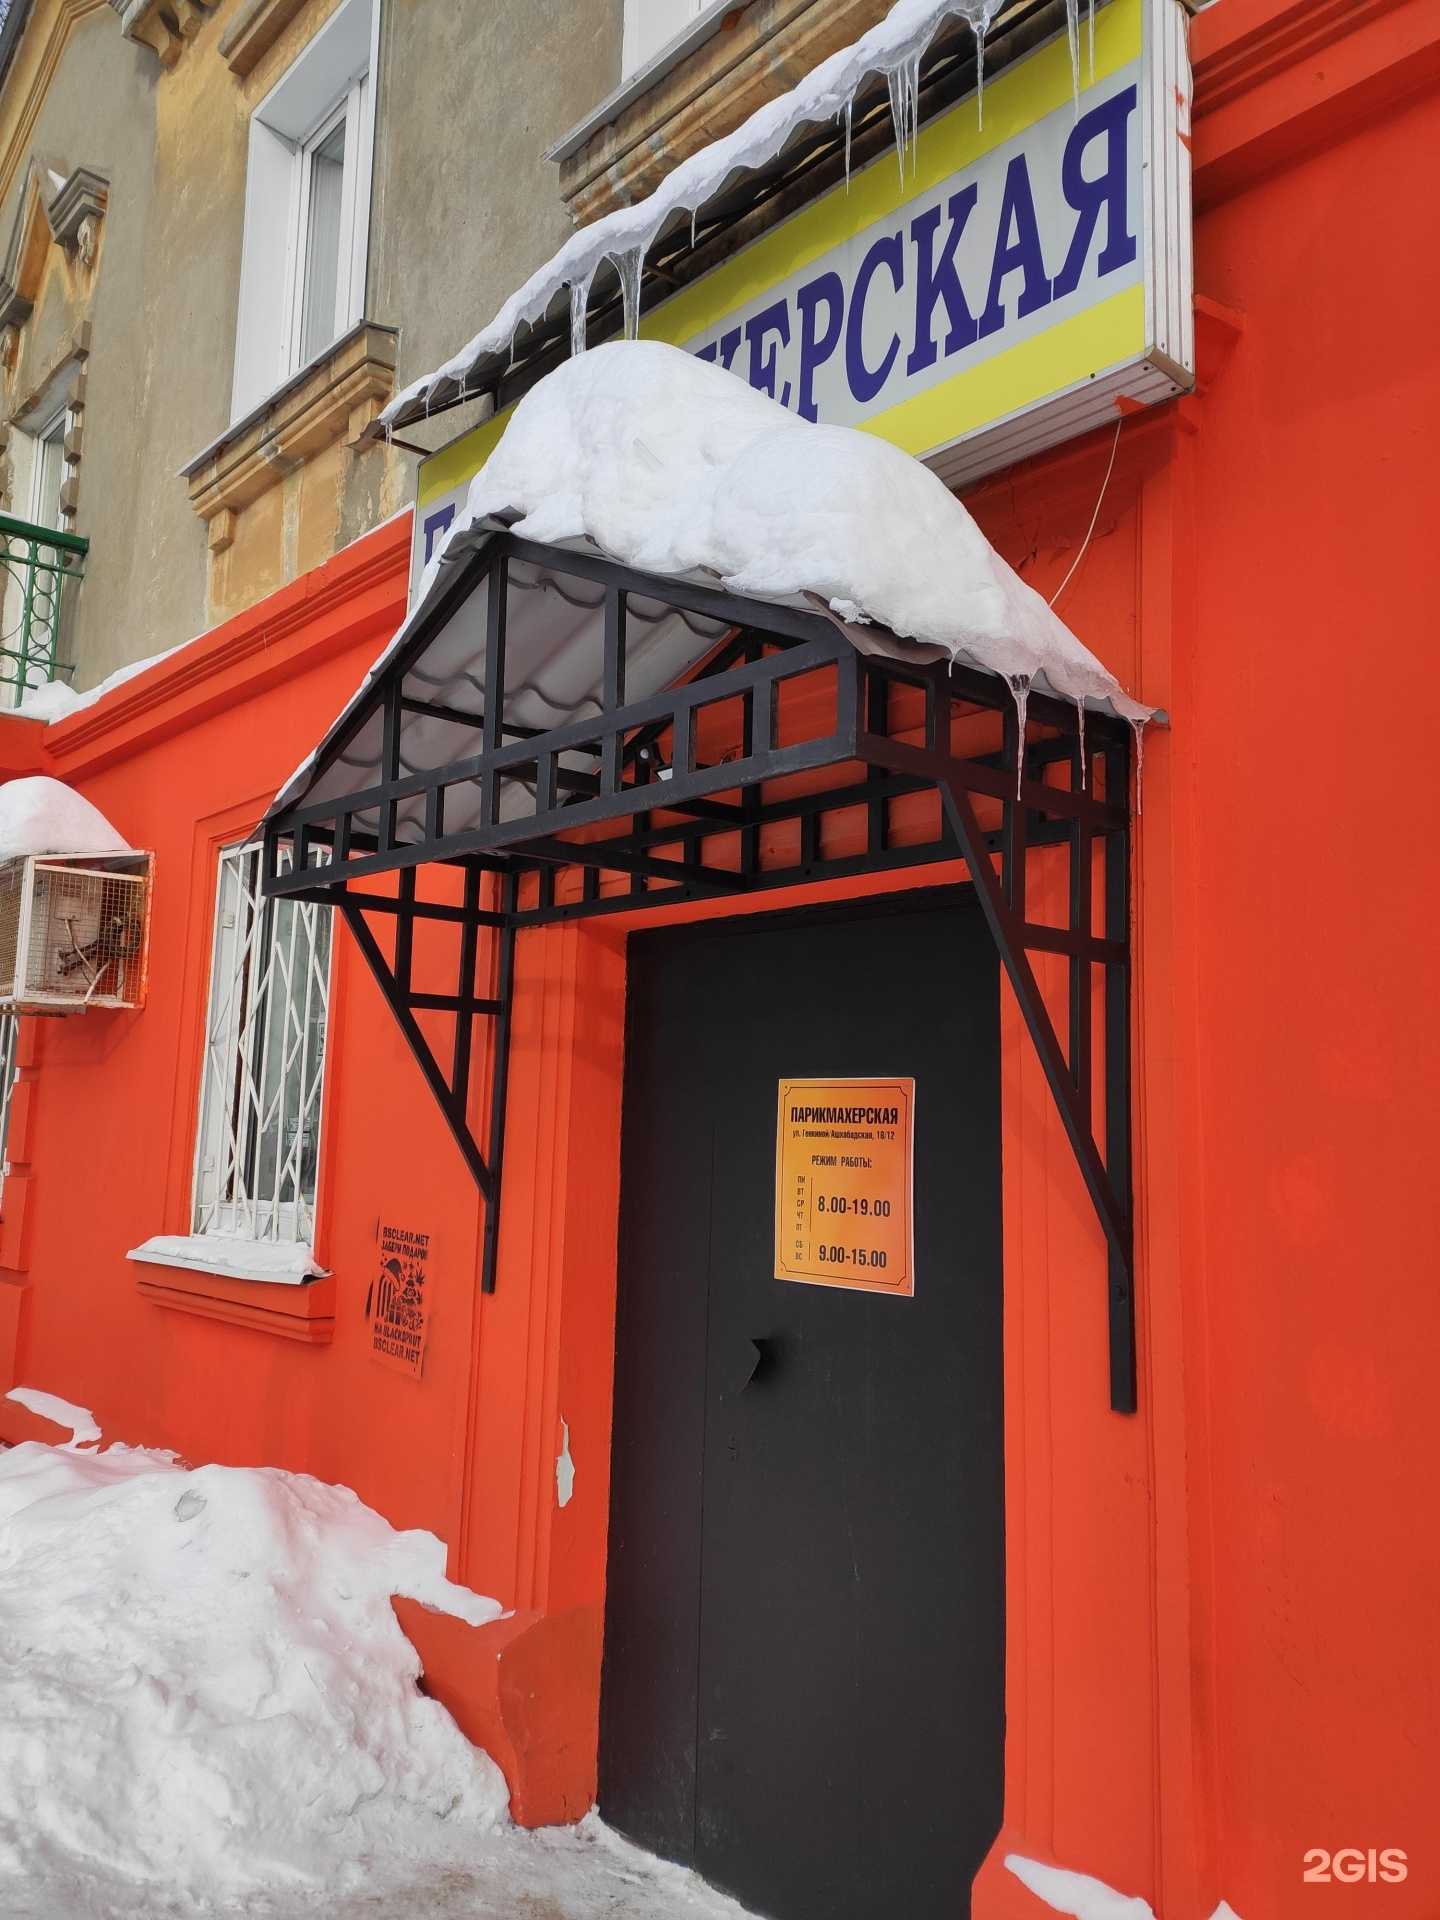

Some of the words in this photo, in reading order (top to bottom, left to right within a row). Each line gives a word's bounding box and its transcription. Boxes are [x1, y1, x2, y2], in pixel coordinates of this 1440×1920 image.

[790, 1106, 898, 1125] ПАРИКМАХЕРСКАЯ
[793, 1130, 801, 1139] ул.
[811, 1155, 837, 1166] РЕЖИМ
[841, 1156, 872, 1168] РАБОТЫ:
[797, 1175, 806, 1184] ПН
[796, 1199, 805, 1208] СР
[818, 1196, 890, 1217] 8.00-19.00
[819, 1245, 887, 1268] 9.00-15.00
